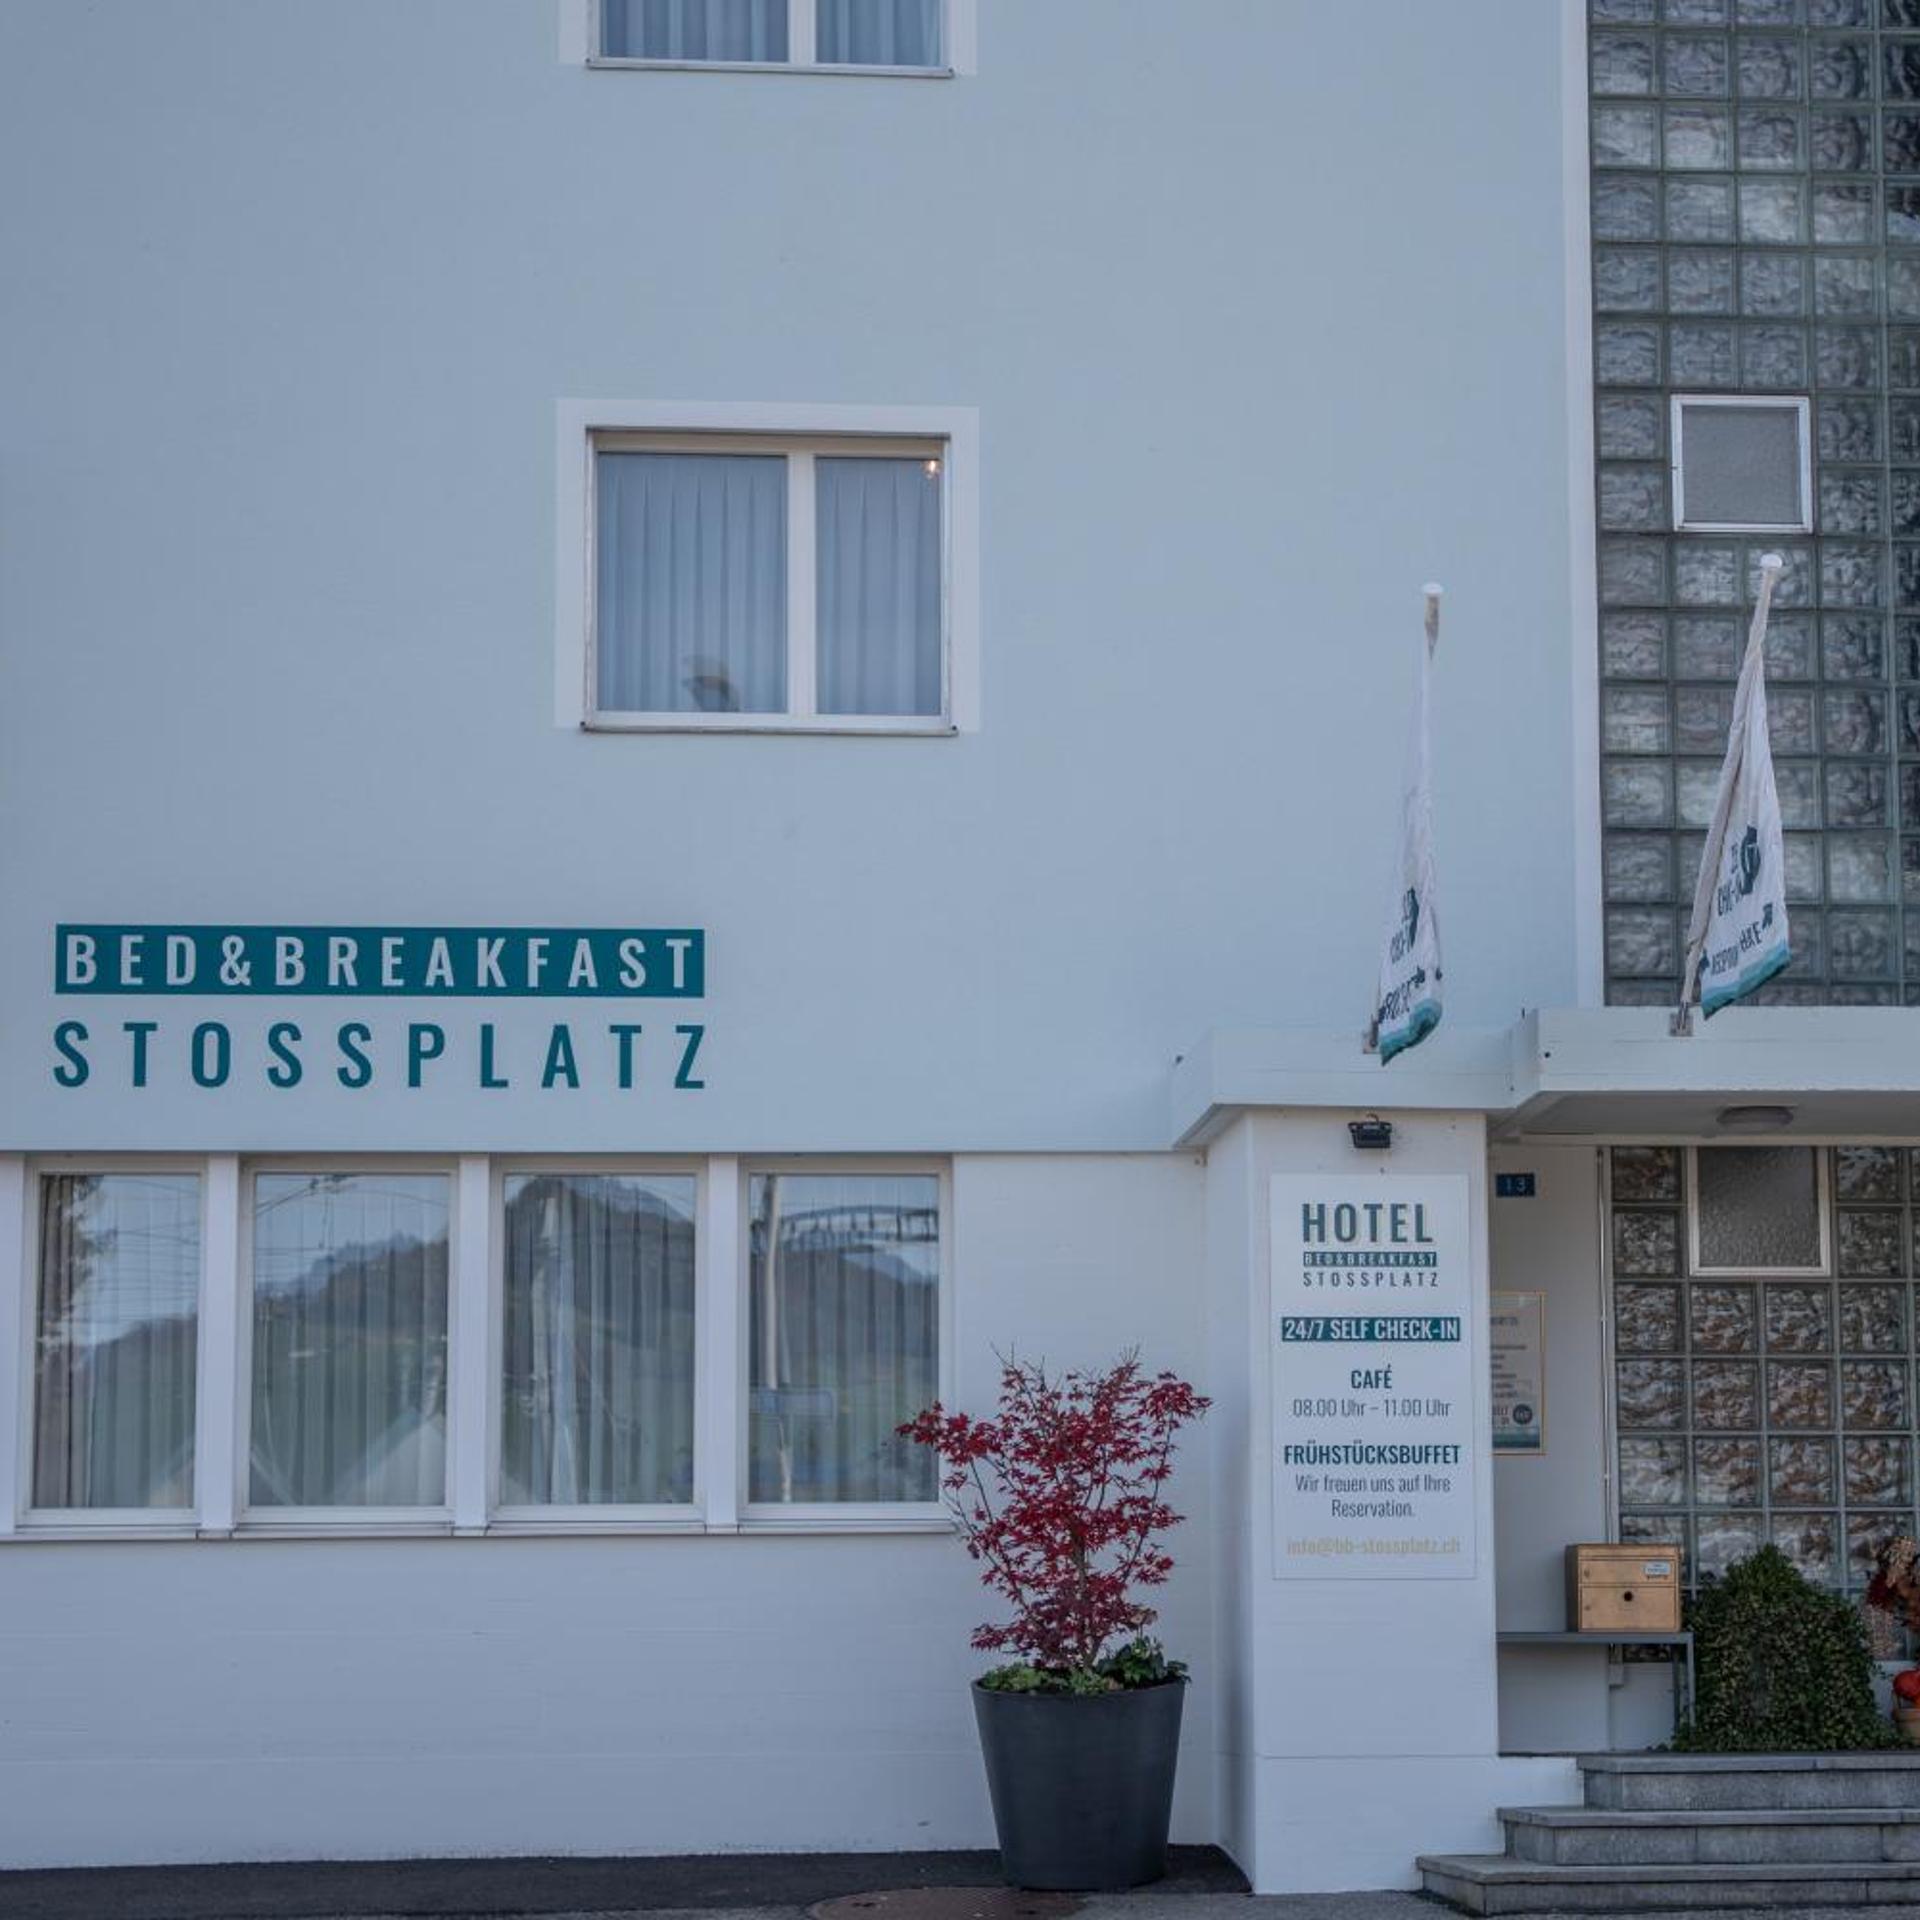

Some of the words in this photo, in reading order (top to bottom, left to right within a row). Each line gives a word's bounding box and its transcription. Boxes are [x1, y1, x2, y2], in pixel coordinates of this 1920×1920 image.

[65, 934, 694, 989] BED&BREAKFAST
[53, 1021, 706, 1089] STOSSPLATZ
[1302, 1203, 1433, 1243] HOTEL
[1304, 1253, 1436, 1267] BED&BREAKFAST
[1303, 1272, 1438, 1287] STOSSPLATZ
[1284, 1319, 1325, 1339] 24/7
[1330, 1319, 1369, 1339] SELF
[1374, 1319, 1458, 1339] CHECK-IN
[1351, 1363, 1393, 1389] CAFÉ
[1293, 1399, 1337, 1417] 08.00
[1341, 1399, 1365, 1417] Uhr
[1384, 1399, 1422, 1417] 11.00
[1426, 1399, 1451, 1417] Uhr
[1284, 1439, 1461, 1465] FRÜHSTÜCKSBUFFET
[1295, 1474, 1319, 1492] Wir
[1324, 1474, 1368, 1492] freuen
[1370, 1478, 1395, 1492] uns
[1399, 1474, 1421, 1492] auf
[1424, 1474, 1451, 1492] Ihre
[1332, 1499, 1416, 1518] Reservation.
